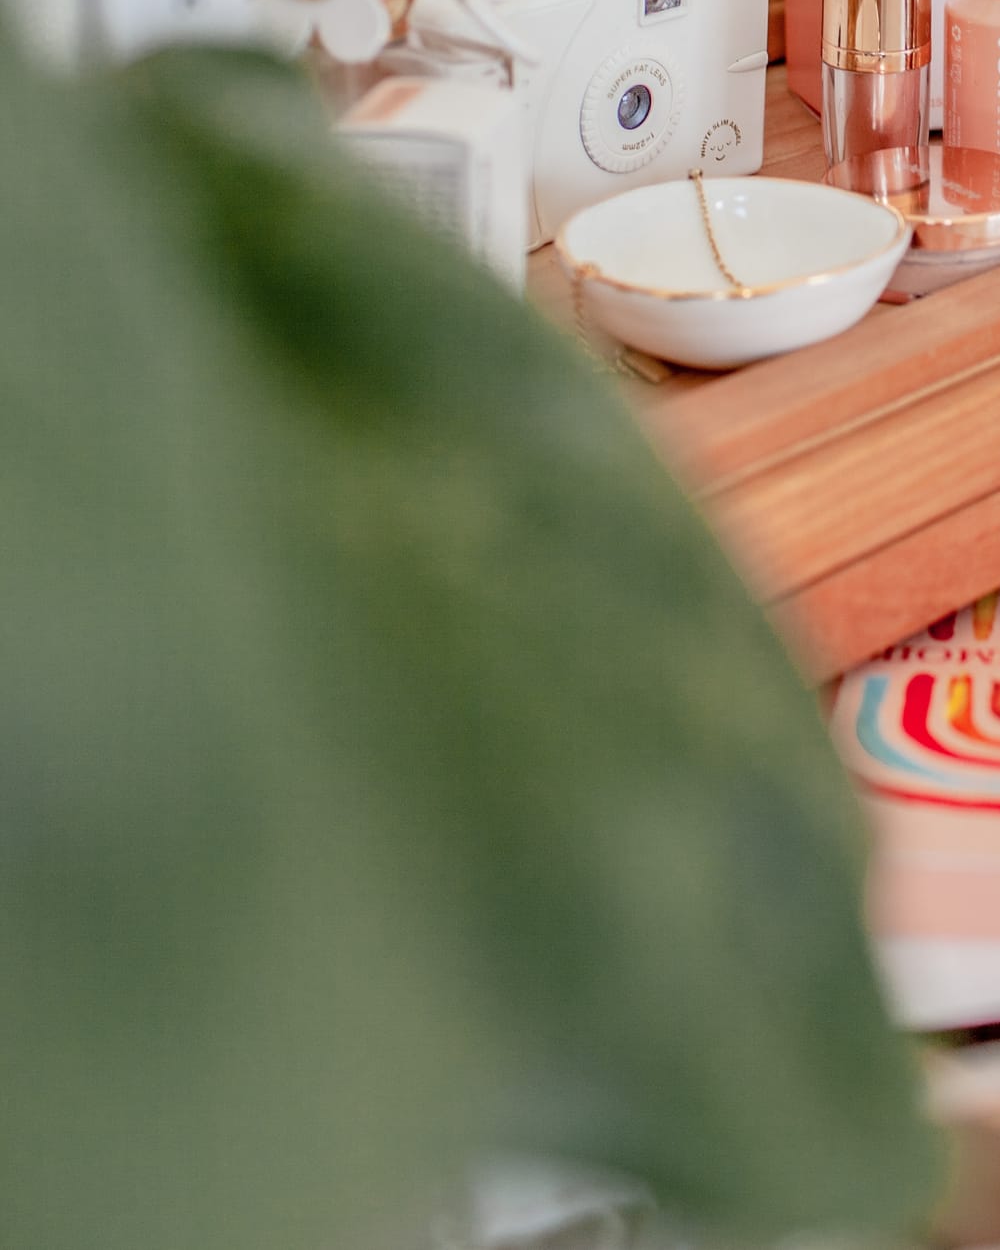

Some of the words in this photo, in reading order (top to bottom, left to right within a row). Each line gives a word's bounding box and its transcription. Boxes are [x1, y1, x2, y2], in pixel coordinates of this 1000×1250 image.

[607, 69, 632, 100] SUPER
[634, 63, 649, 73] FAT
[650, 67, 667, 87] LENS
[700, 129, 712, 159] WHITE
